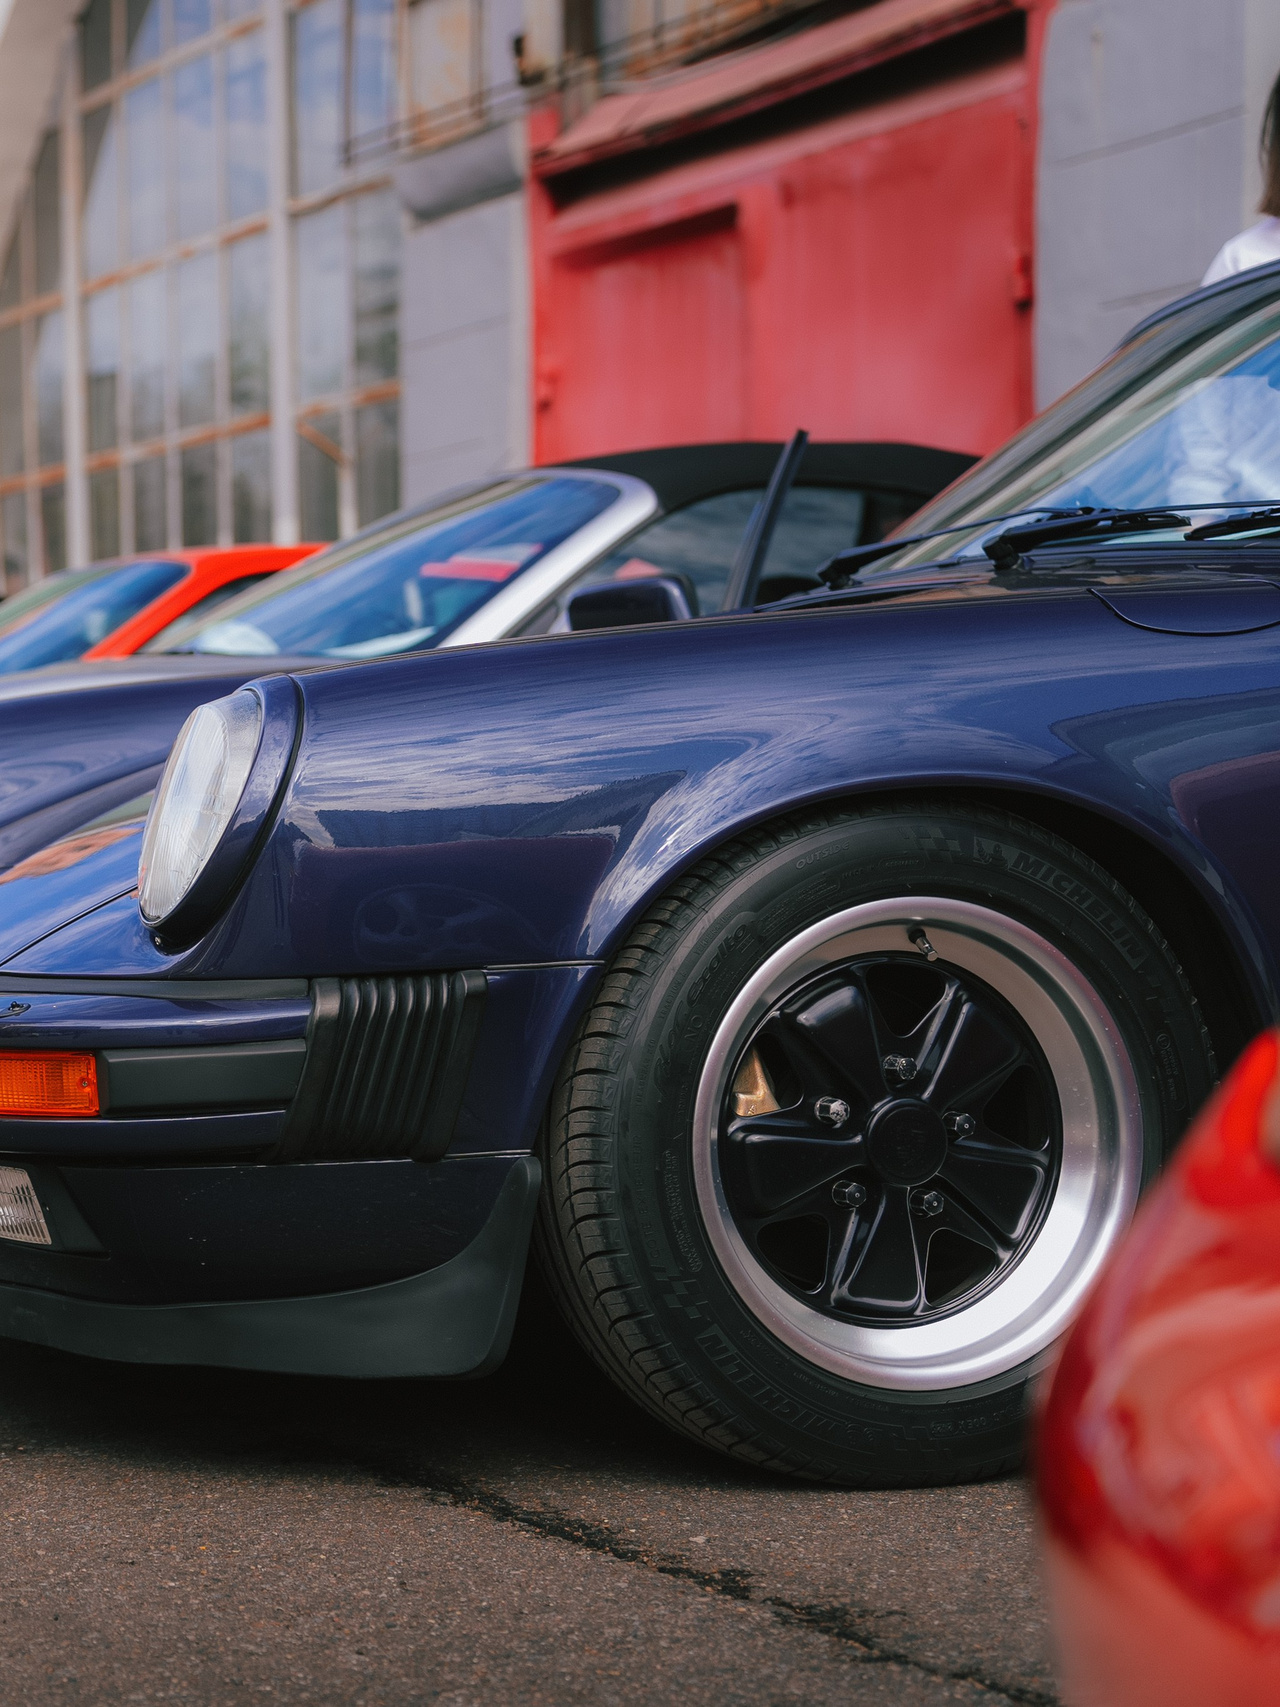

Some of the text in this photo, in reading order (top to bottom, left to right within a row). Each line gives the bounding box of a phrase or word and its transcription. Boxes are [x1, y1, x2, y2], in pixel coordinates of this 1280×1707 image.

[795, 841, 850, 871] OUTSIDE
[1012, 850, 1143, 962] MICHELIN
[687, 921, 749, 1007] Exalto
[697, 1331, 844, 1440] MICHELIN
